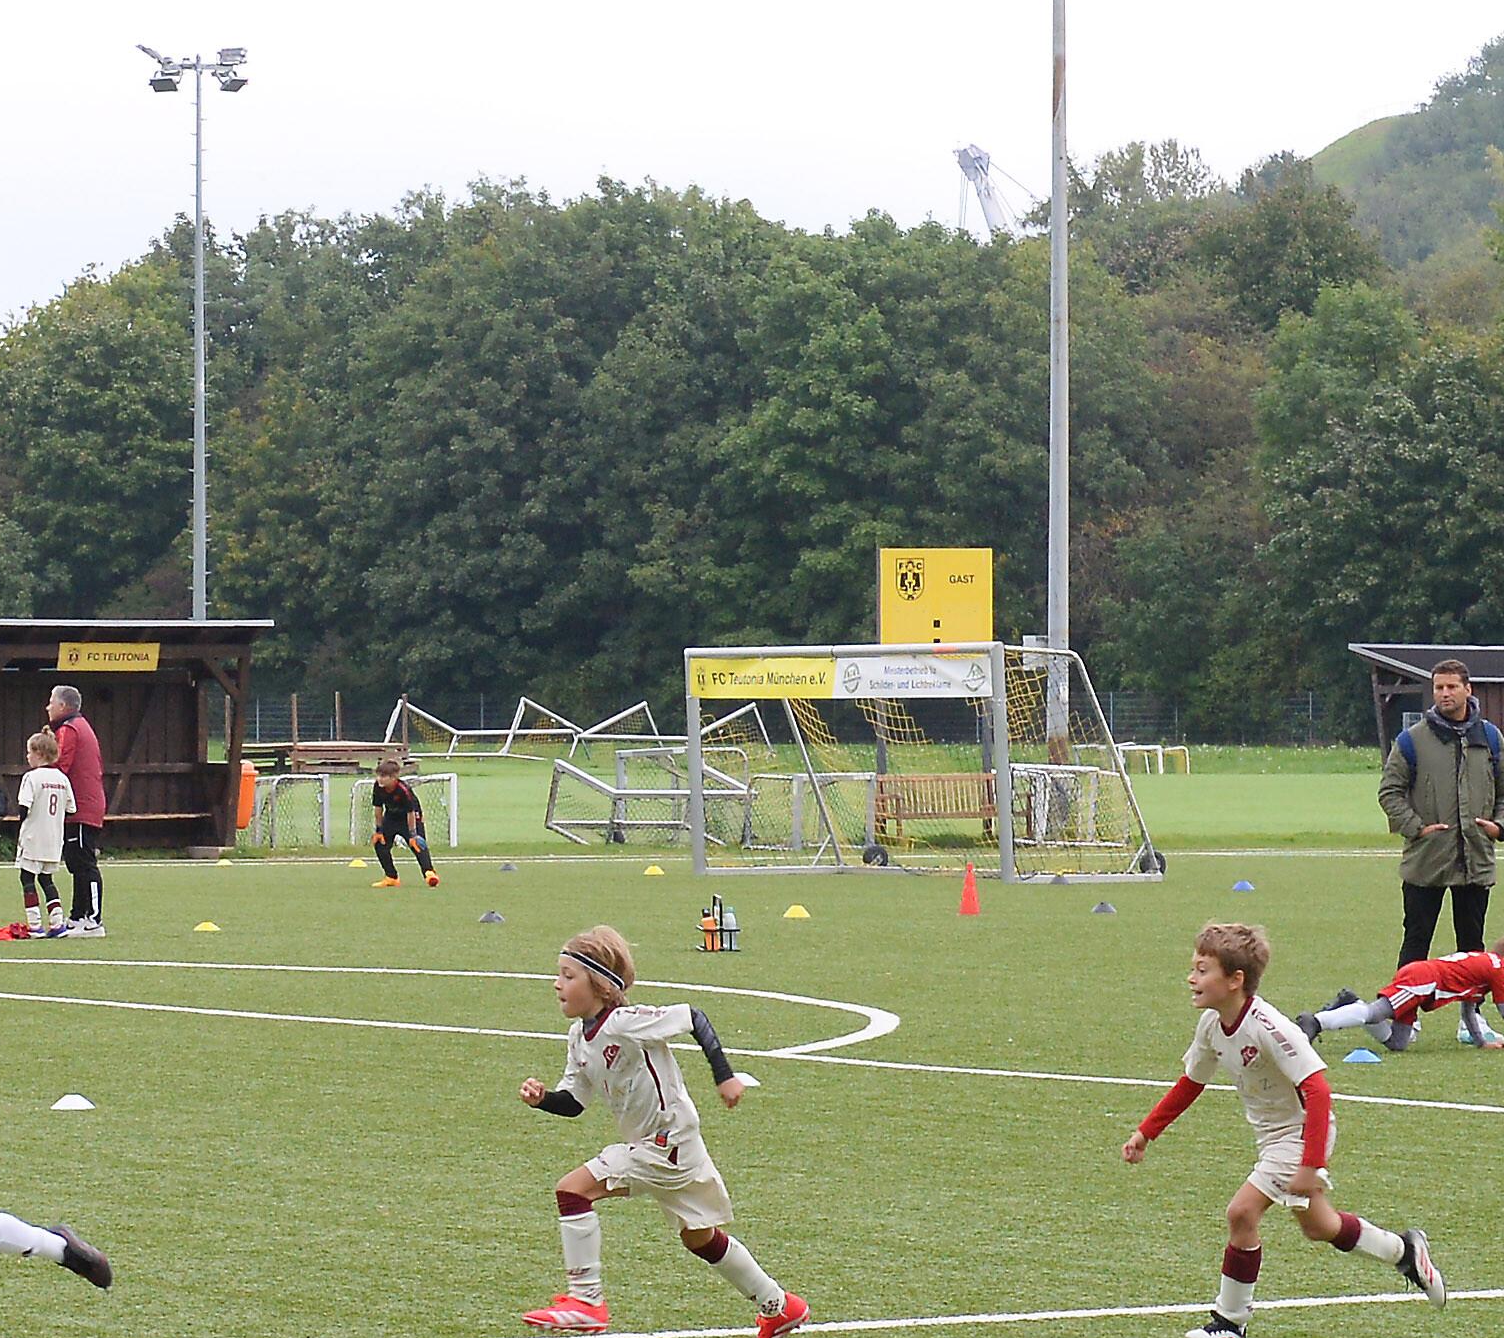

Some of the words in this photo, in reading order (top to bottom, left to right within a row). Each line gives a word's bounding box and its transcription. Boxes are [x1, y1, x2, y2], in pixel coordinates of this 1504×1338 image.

[949, 574, 975, 584] GAST
[87, 652, 100, 661] FC
[103, 652, 150, 662] TEUTONIA
[711, 672, 726, 685] FC
[729, 672, 764, 685] Teutonia
[766, 672, 807, 685] München
[809, 672, 826, 685] e.V.
[49, 793, 58, 816] 8
